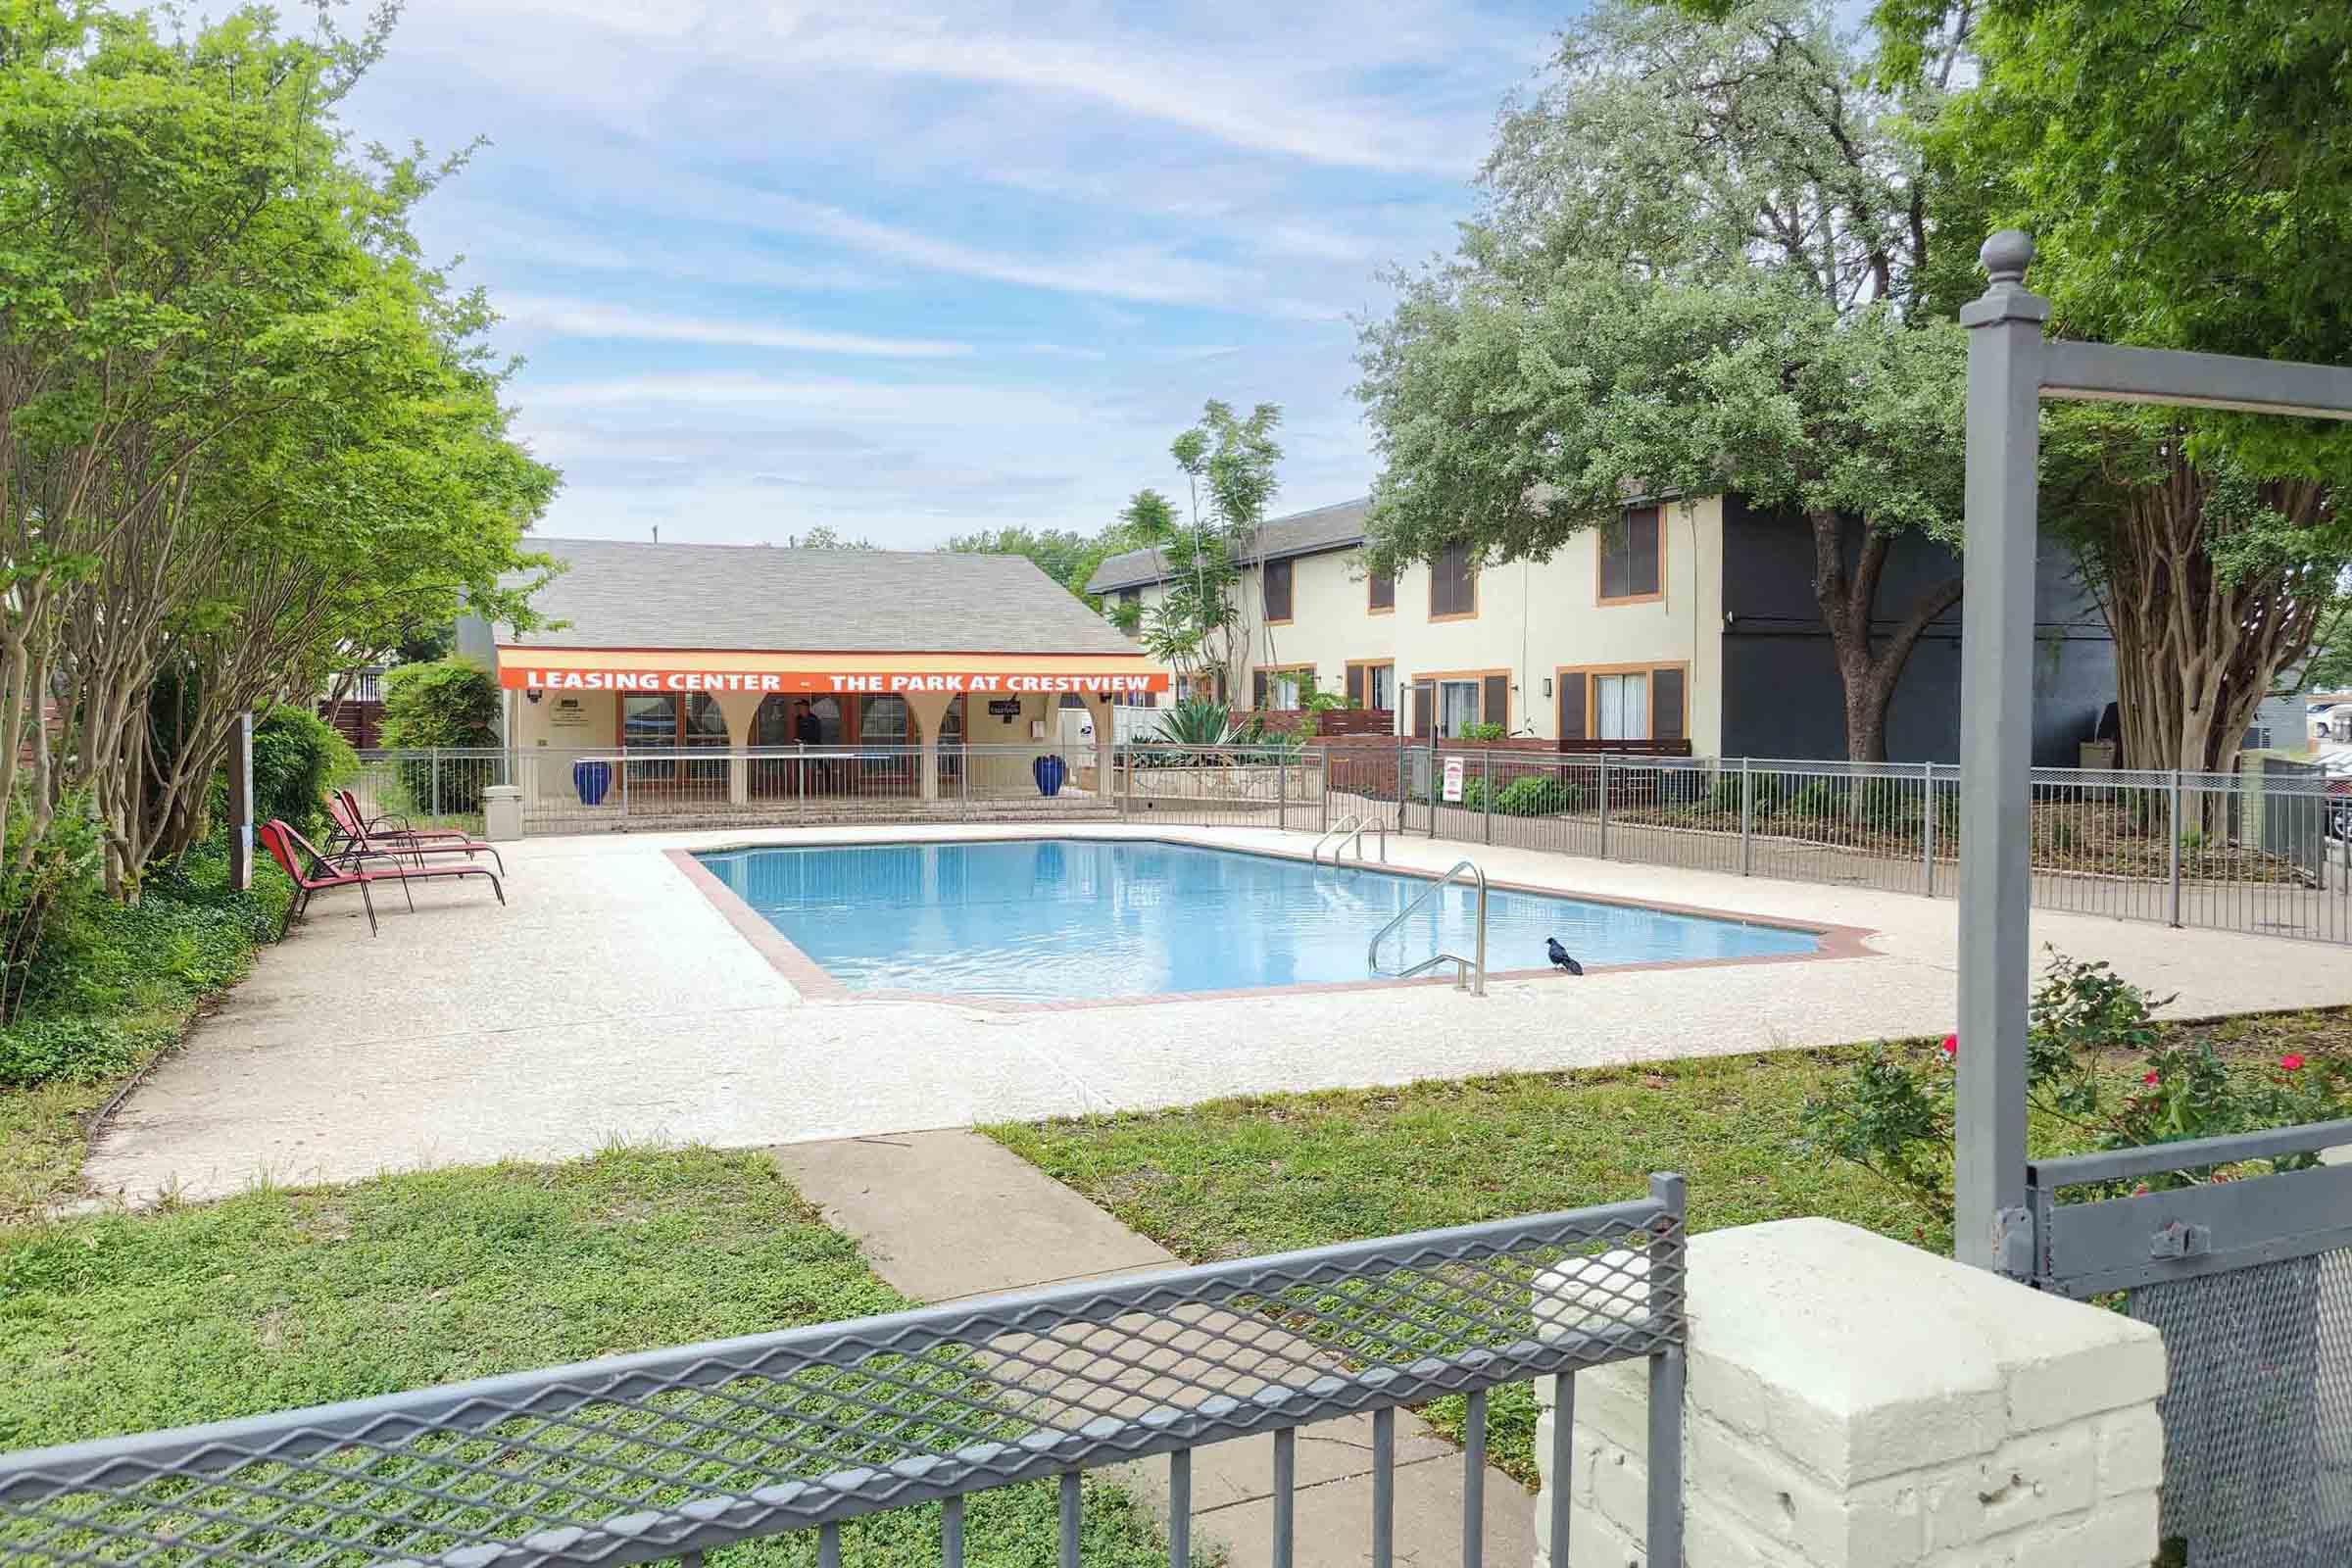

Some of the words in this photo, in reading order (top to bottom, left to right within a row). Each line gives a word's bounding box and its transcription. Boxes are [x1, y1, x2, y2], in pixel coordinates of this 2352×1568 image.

[527, 671, 659, 689] LEASING
[667, 673, 780, 690] CENTER
[831, 676, 883, 691] THE
[891, 676, 962, 691] PARK
[969, 676, 1001, 691] AT
[1006, 676, 1150, 691] CRESTVIEW
